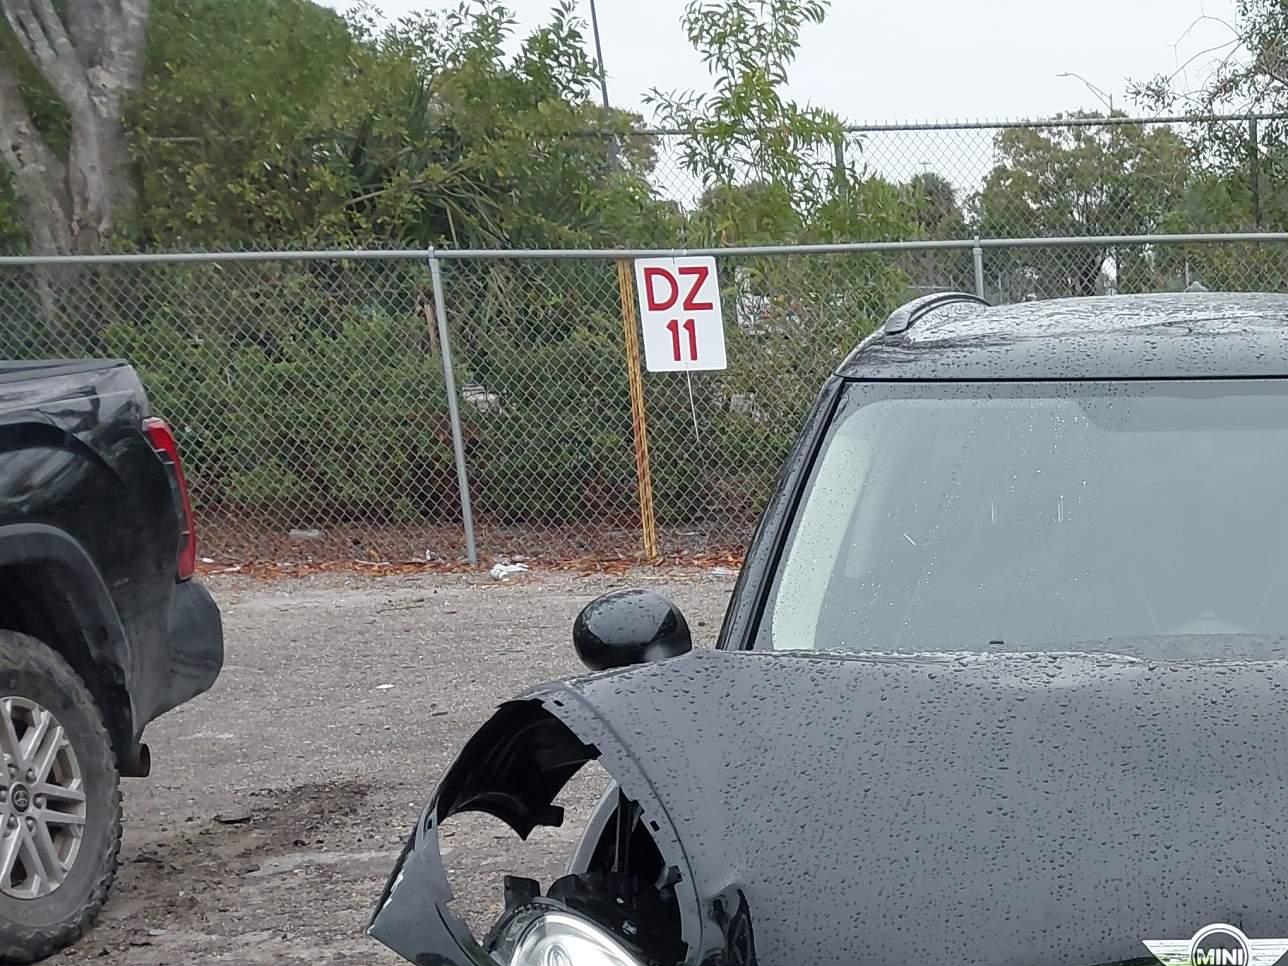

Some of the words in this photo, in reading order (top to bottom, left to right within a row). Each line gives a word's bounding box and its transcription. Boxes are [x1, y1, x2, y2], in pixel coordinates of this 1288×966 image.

[643, 266, 714, 311] DZ
[666, 318, 698, 361] 11
[1196, 948, 1244, 966] MINI
